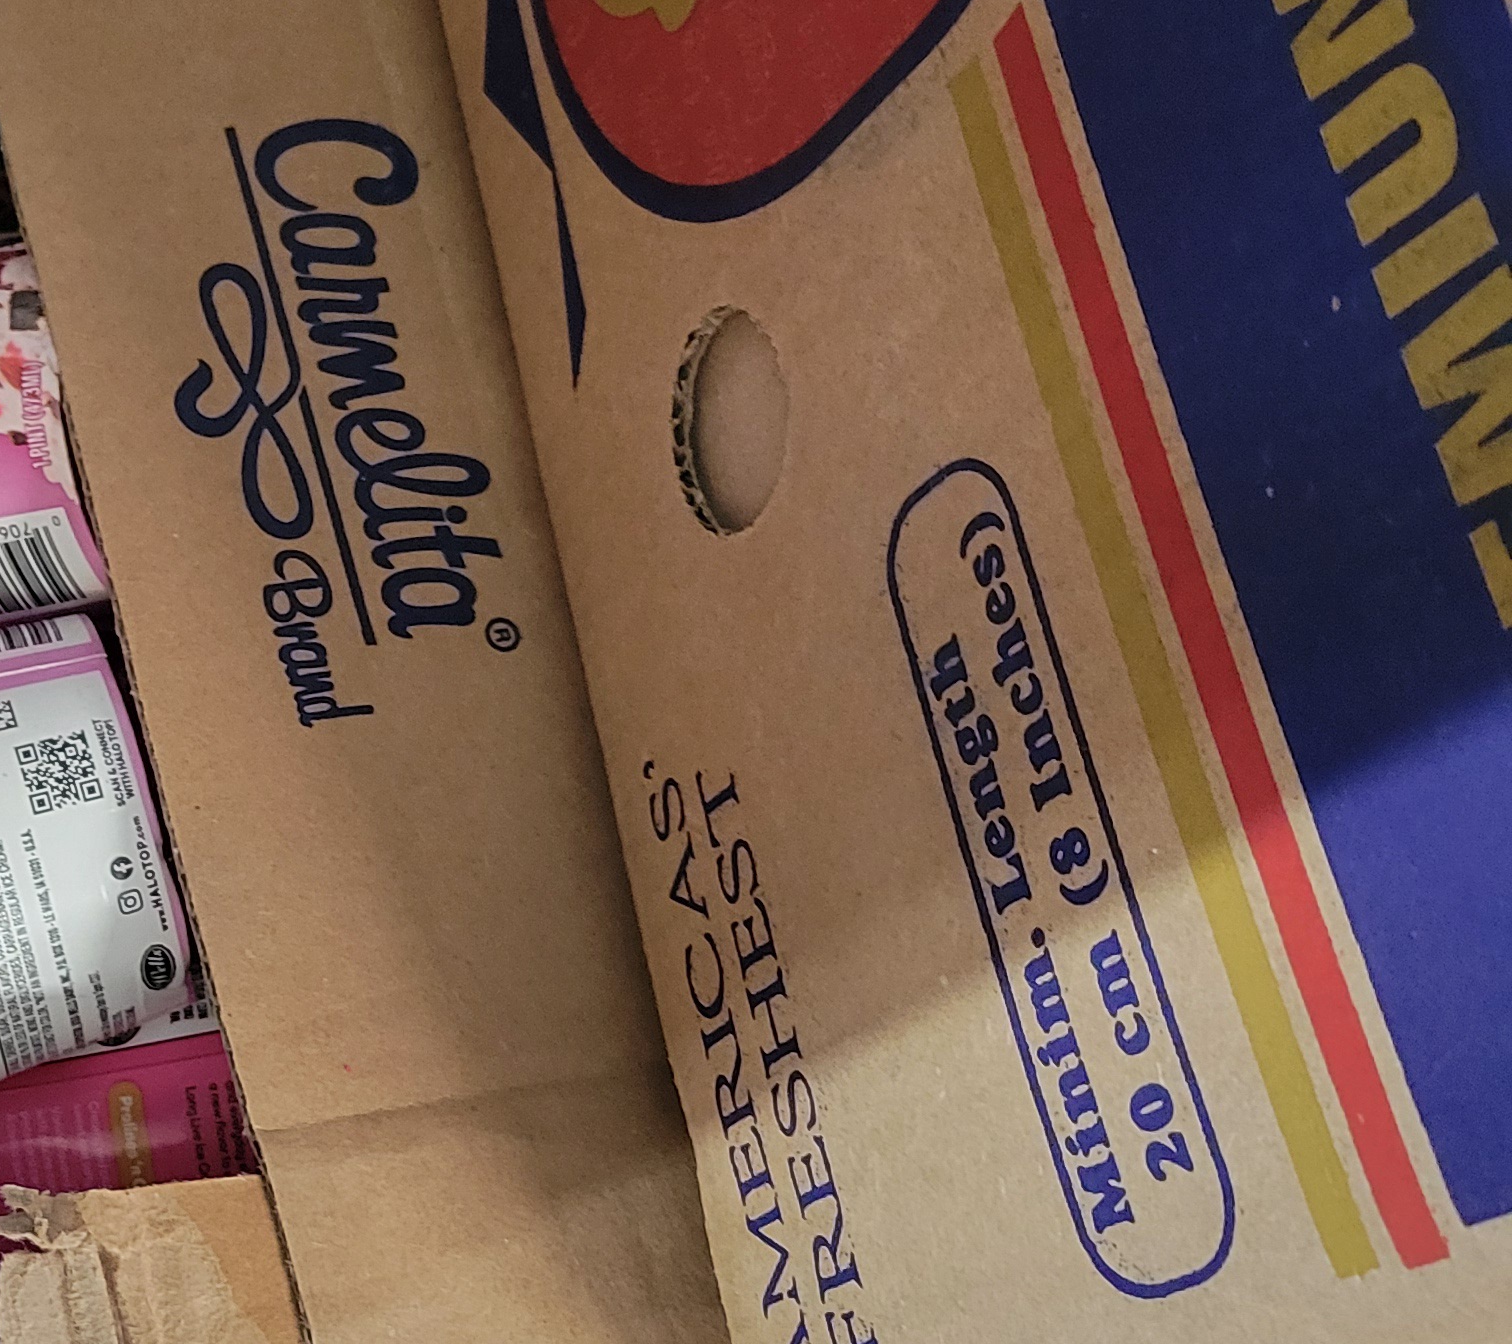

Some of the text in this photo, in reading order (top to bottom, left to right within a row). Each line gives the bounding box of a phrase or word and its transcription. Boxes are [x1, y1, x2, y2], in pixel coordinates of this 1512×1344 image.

[254, 118, 503, 640] Carmelita
[21, 422, 52, 458] PINT
[53, 516, 62, 527] 0
[263, 549, 374, 728] Brand
[90, 716, 116, 768] CONNECT
[109, 741, 136, 800] WITH HALO
[960, 511, 1196, 1183] 20 cm (8 Inches)
[928, 633, 1136, 1234] Minim. Length
[118, 1094, 141, 1158] Pralines
[182, 1085, 201, 1117] Long
[189, 1116, 204, 1141] Live
